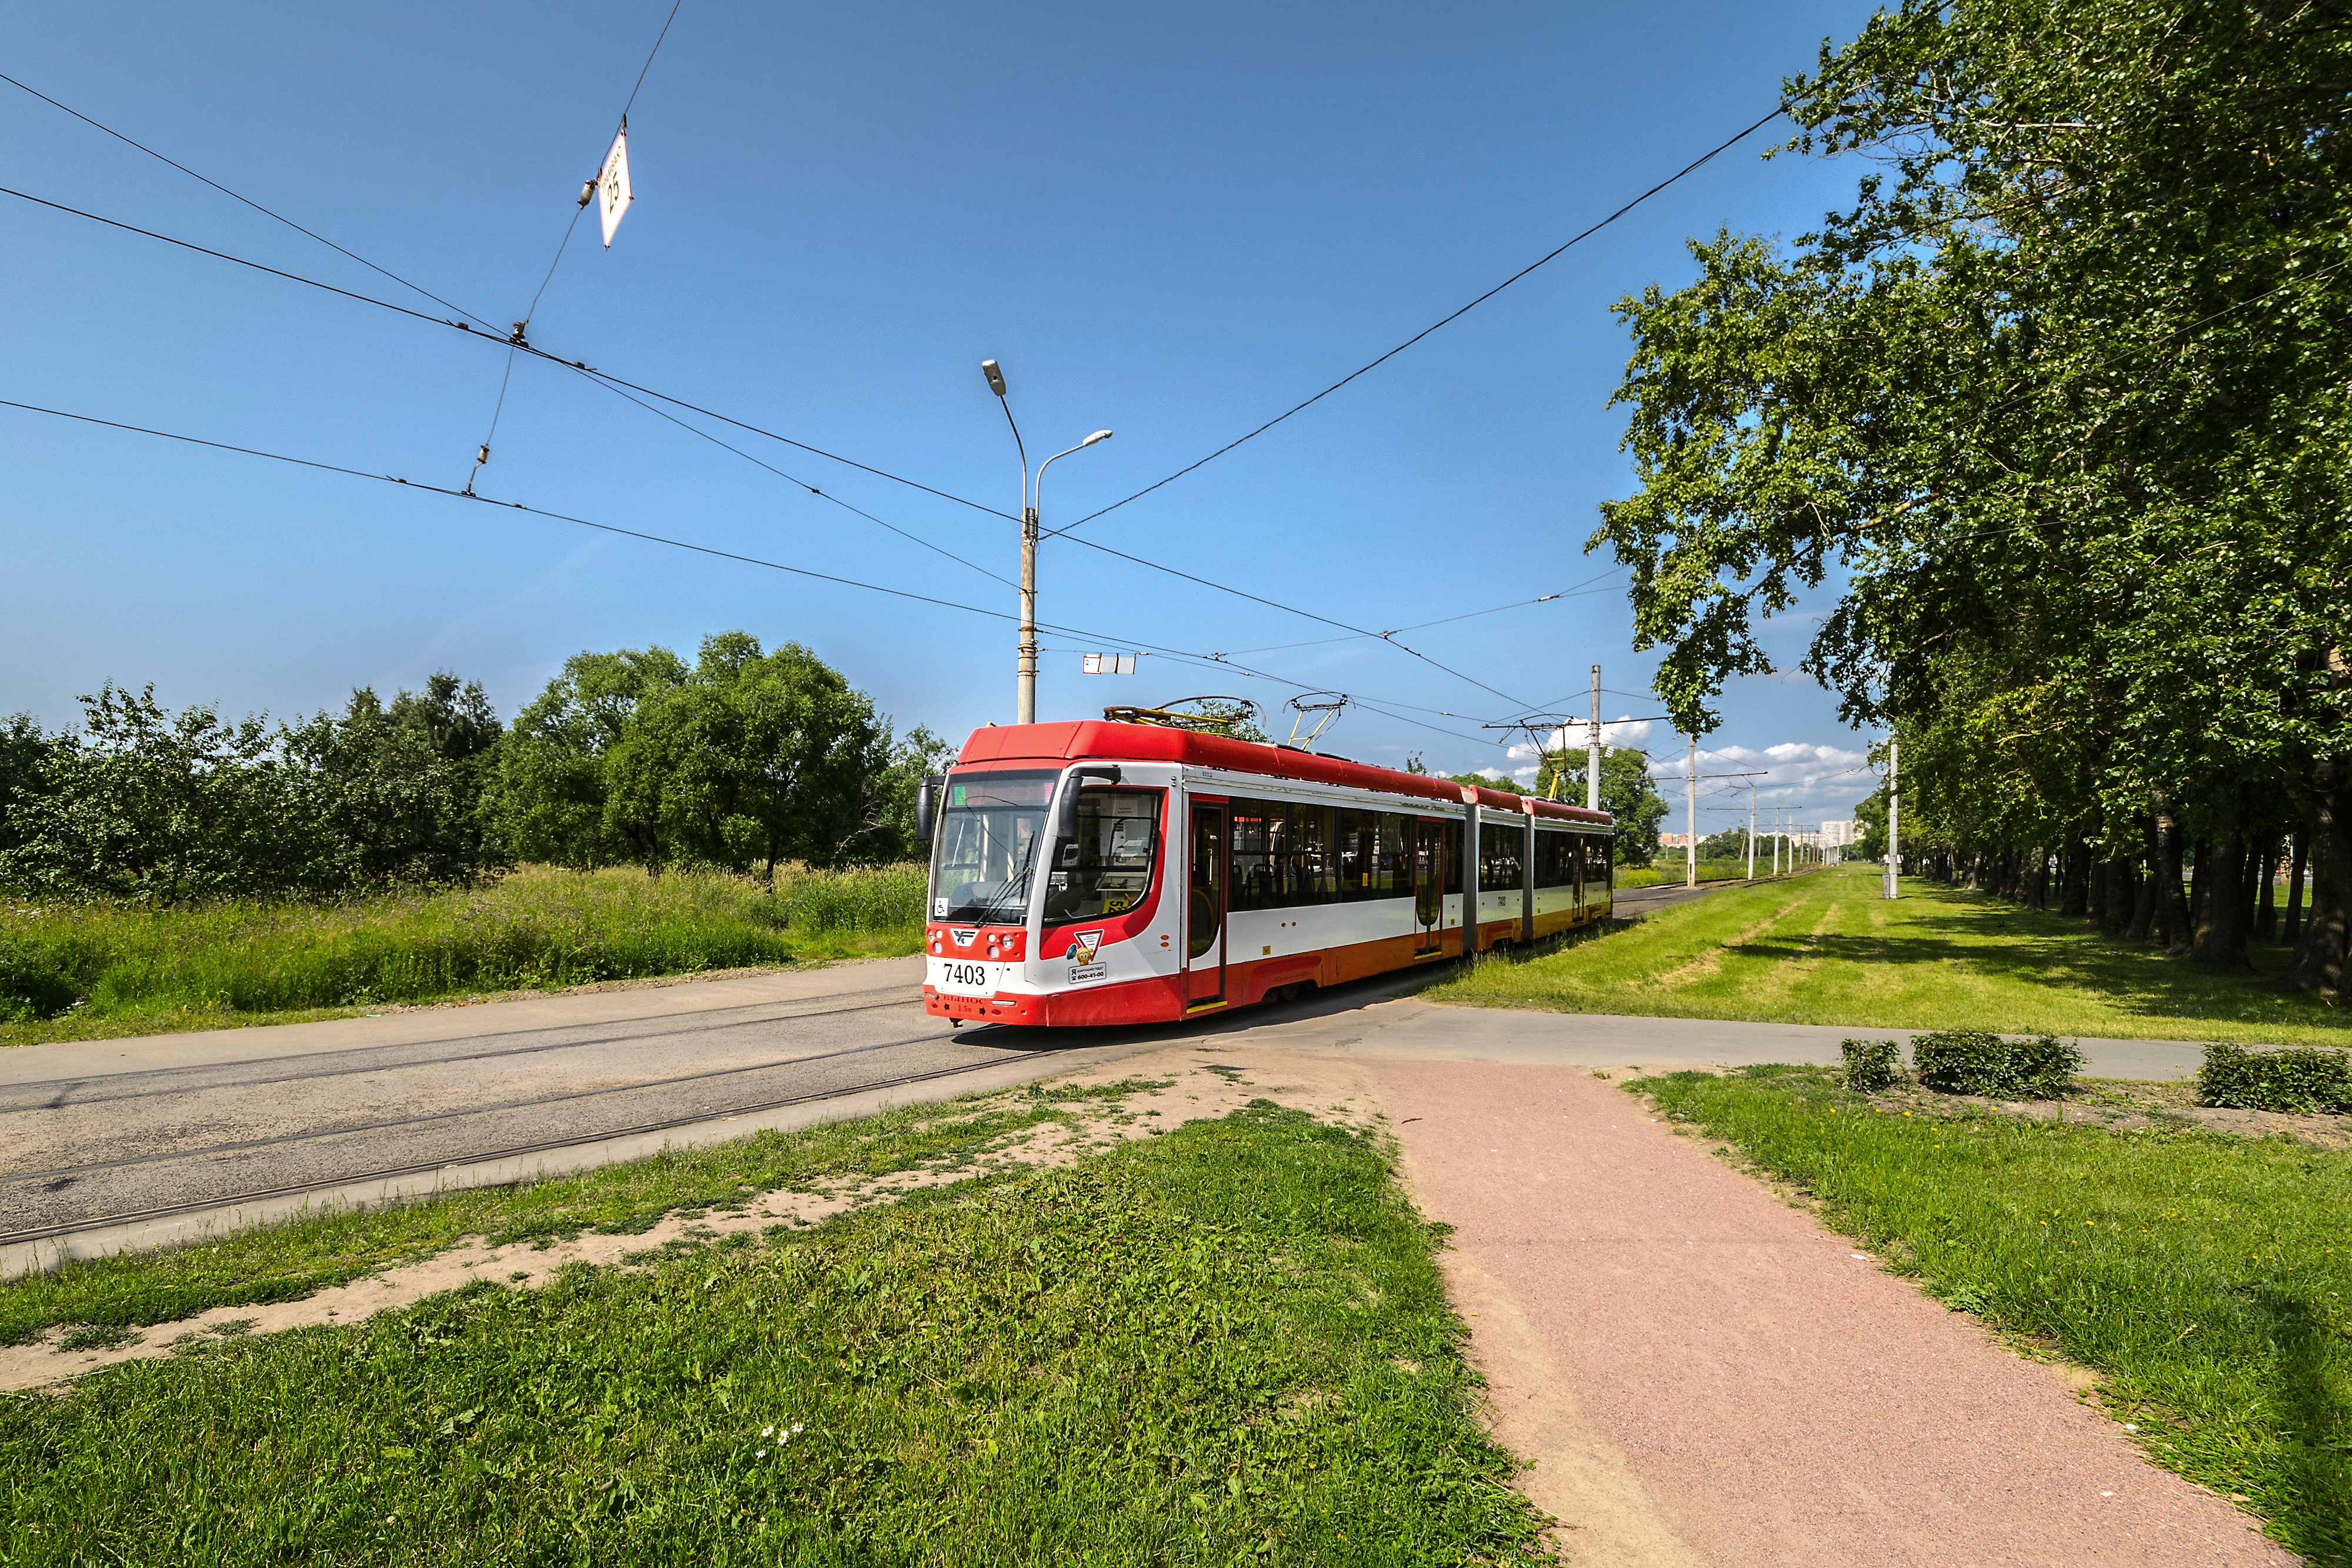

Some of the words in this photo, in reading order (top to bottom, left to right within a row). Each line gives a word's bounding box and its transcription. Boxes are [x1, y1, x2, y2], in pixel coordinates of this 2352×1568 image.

[607, 170, 619, 214] 25
[944, 964, 985, 985] 7403
[944, 995, 987, 1004] ВЫНОС
